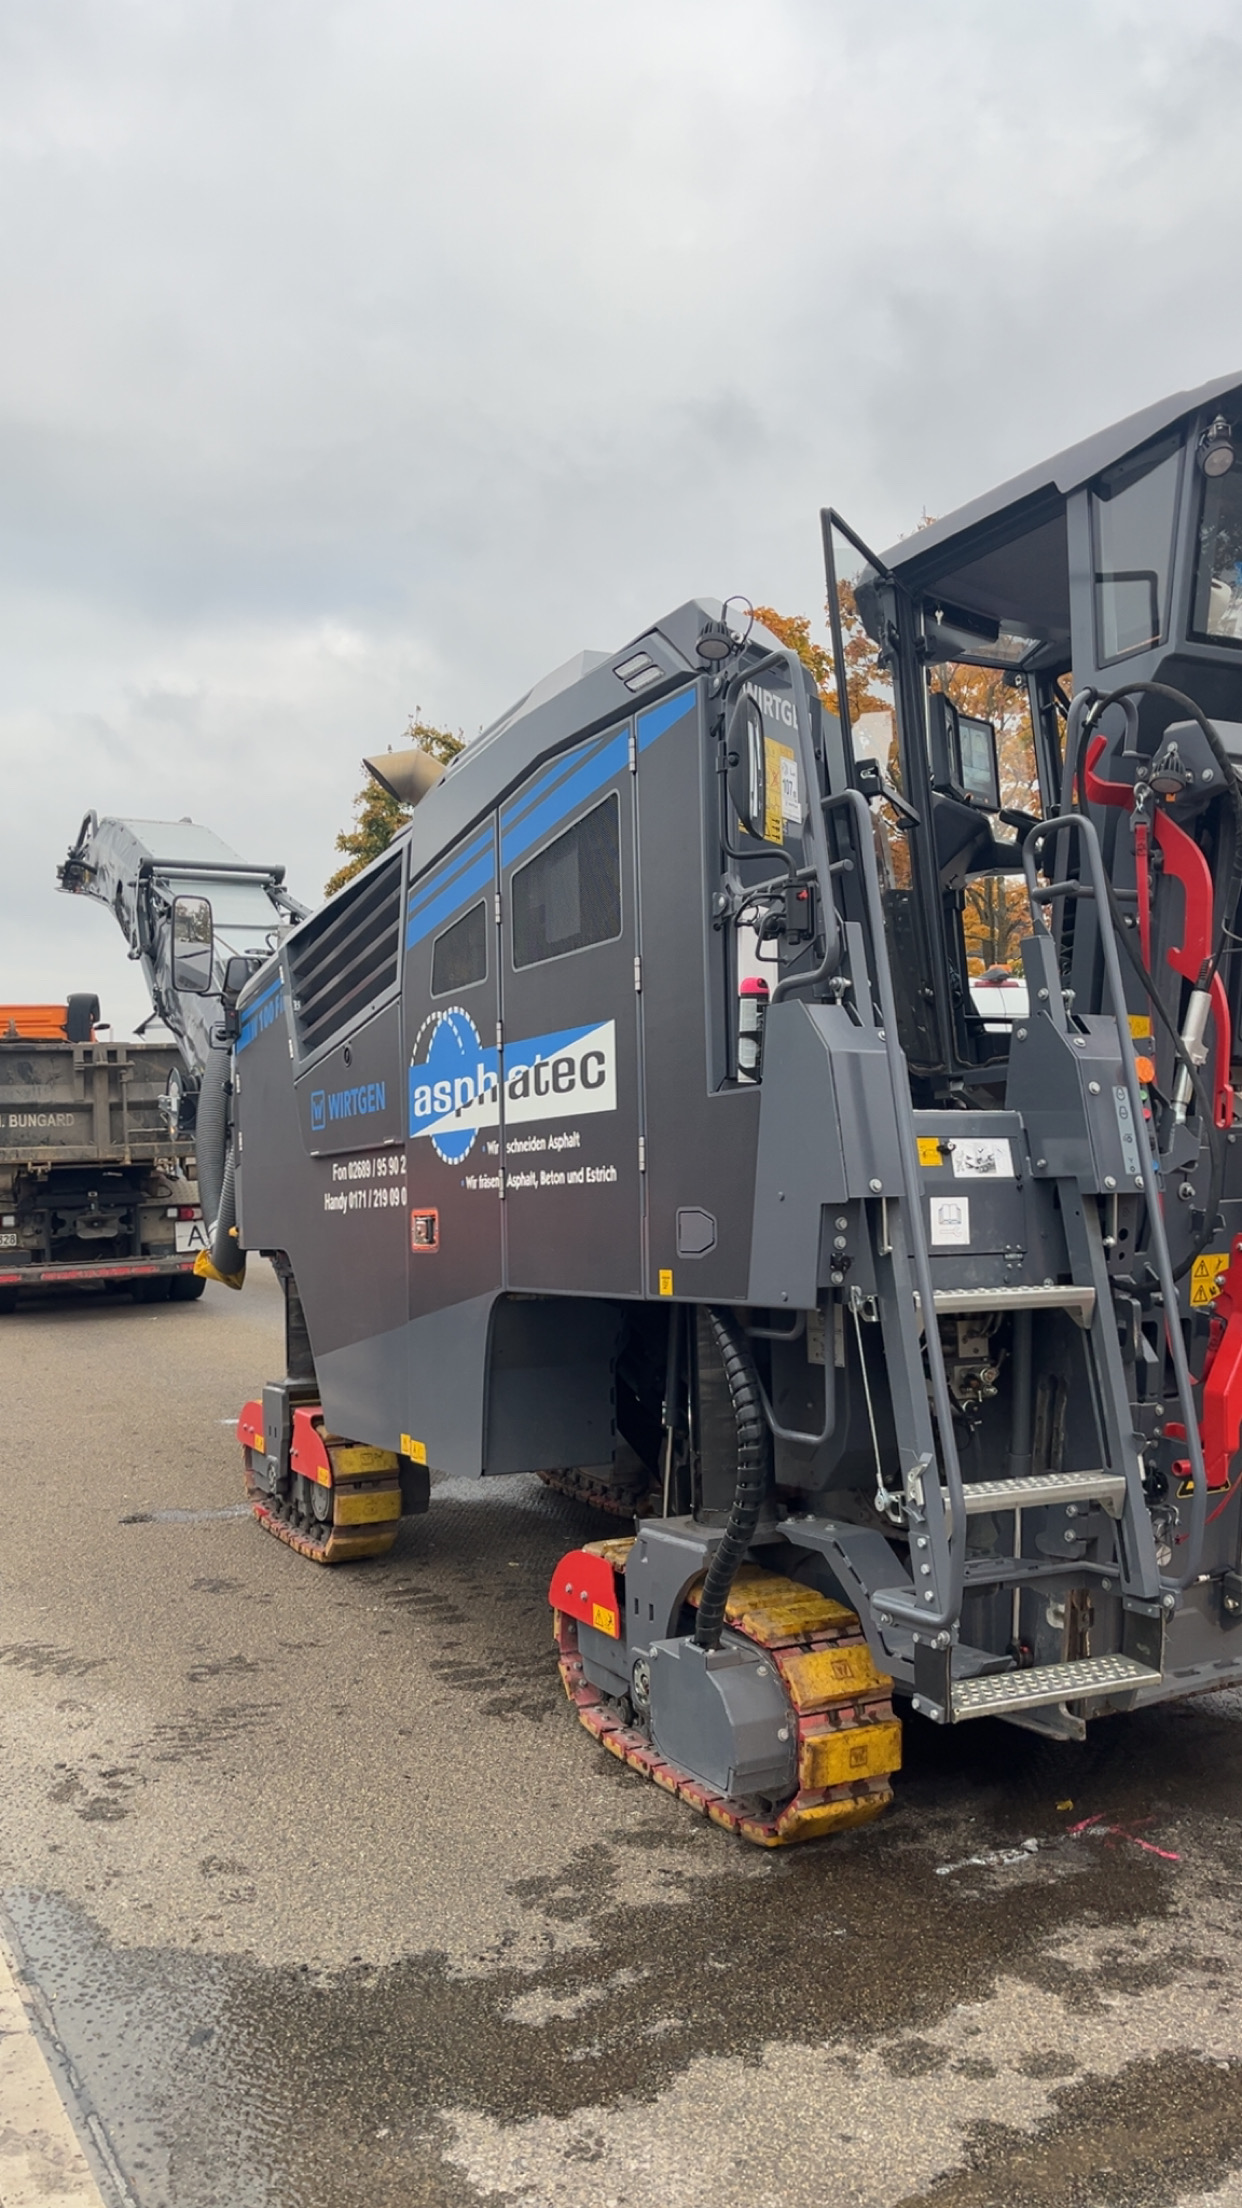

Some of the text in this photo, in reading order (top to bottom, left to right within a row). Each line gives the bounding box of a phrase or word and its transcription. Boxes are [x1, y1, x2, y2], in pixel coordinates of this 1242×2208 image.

[742, 681, 812, 732] WIRTG
[413, 1050, 606, 1118] asphatec
[328, 1081, 386, 1120] WIRTGEN
[8, 1113, 75, 1128] BUNGARD
[486, 1131, 580, 1155] Wir schneiden Asphalt
[332, 1163, 347, 1181] Fon
[377, 1157, 387, 1177] 95
[388, 1155, 399, 1176] 90
[400, 1154, 407, 1174] 2
[465, 1174, 477, 1190] Wir
[506, 1170, 539, 1190] Asphalt,
[540, 1170, 565, 1186] Beton
[566, 1167, 584, 1184] und
[586, 1165, 618, 1183] Estrich
[324, 1191, 348, 1214] Handy
[348, 1190, 367, 1209] 0171
[373, 1187, 388, 1208] 219
[389, 1186, 400, 1207] 09
[187, 1224, 206, 1248] A
